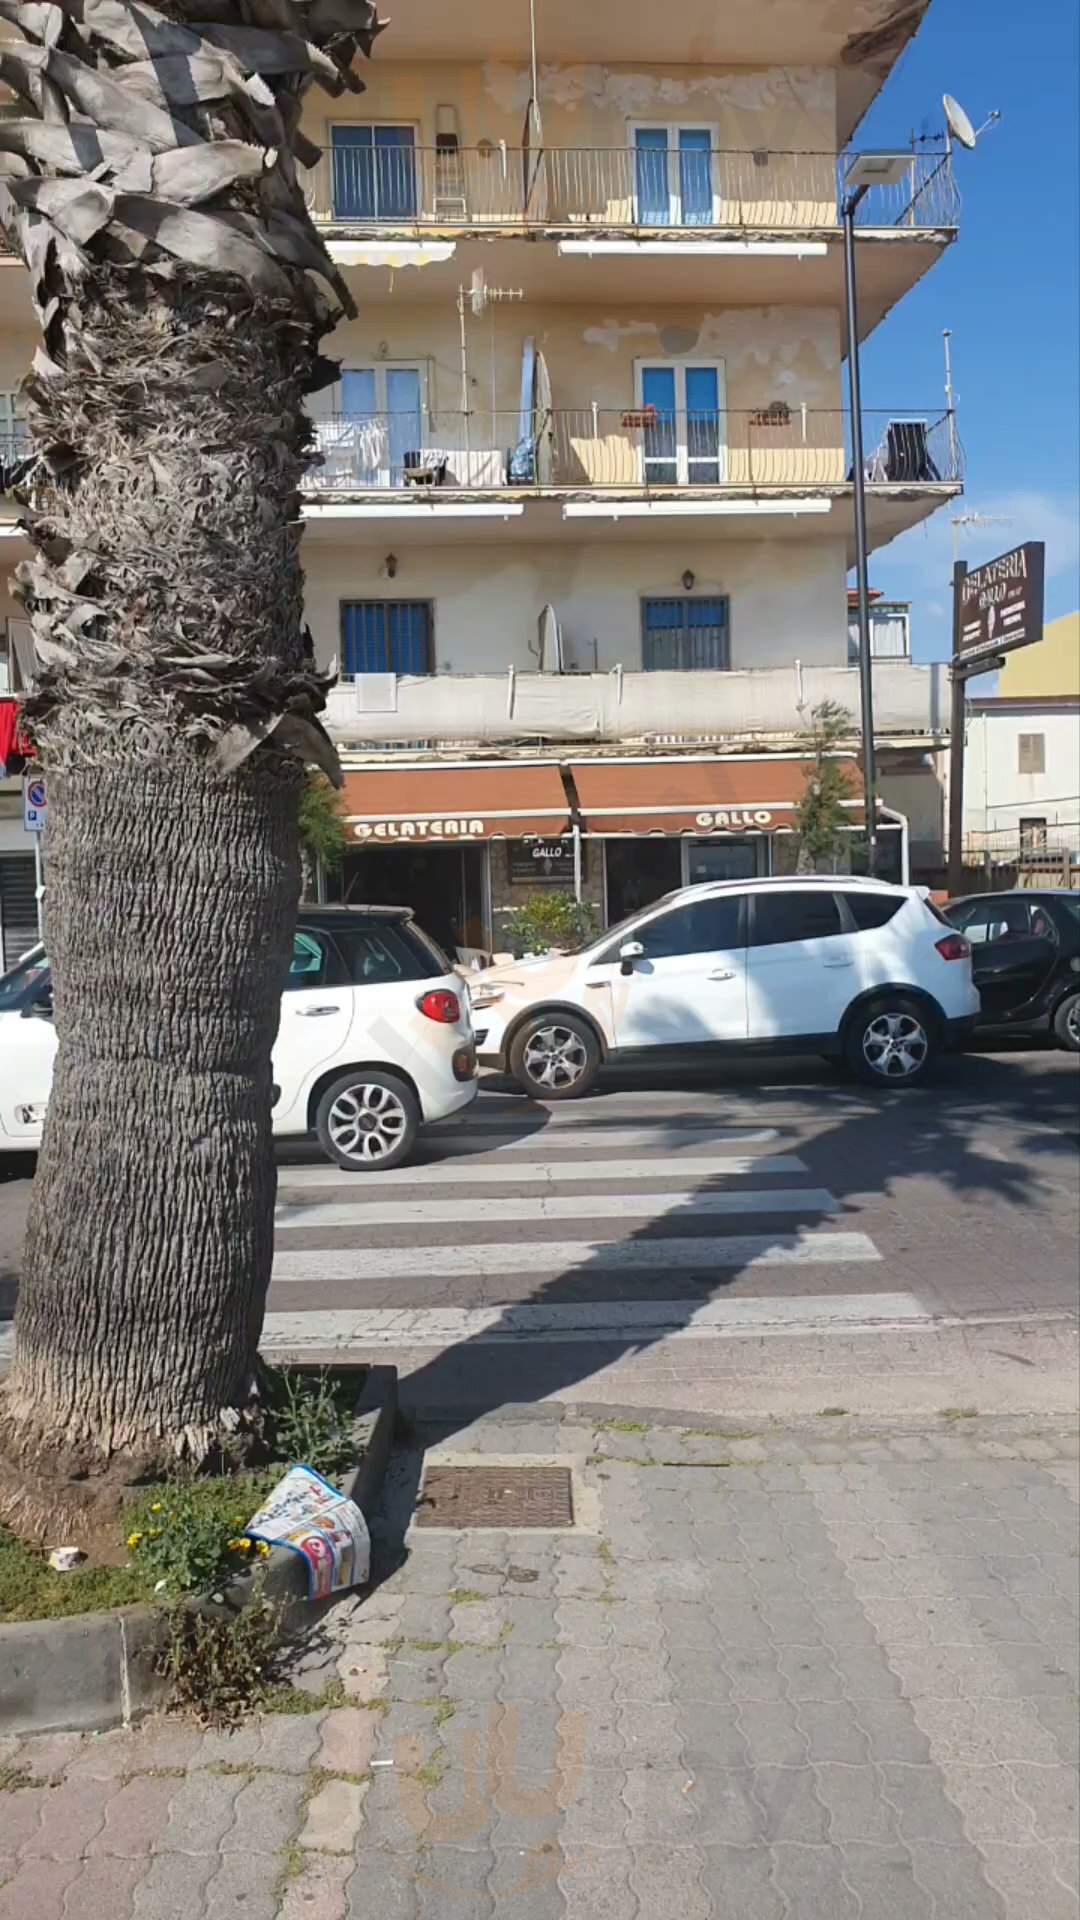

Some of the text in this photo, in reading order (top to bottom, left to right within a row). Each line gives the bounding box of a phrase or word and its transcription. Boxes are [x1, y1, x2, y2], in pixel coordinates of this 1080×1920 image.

[696, 811, 771, 826] GALLO
[354, 820, 483, 837] GELATERIA
[532, 846, 562, 858] GALLO
